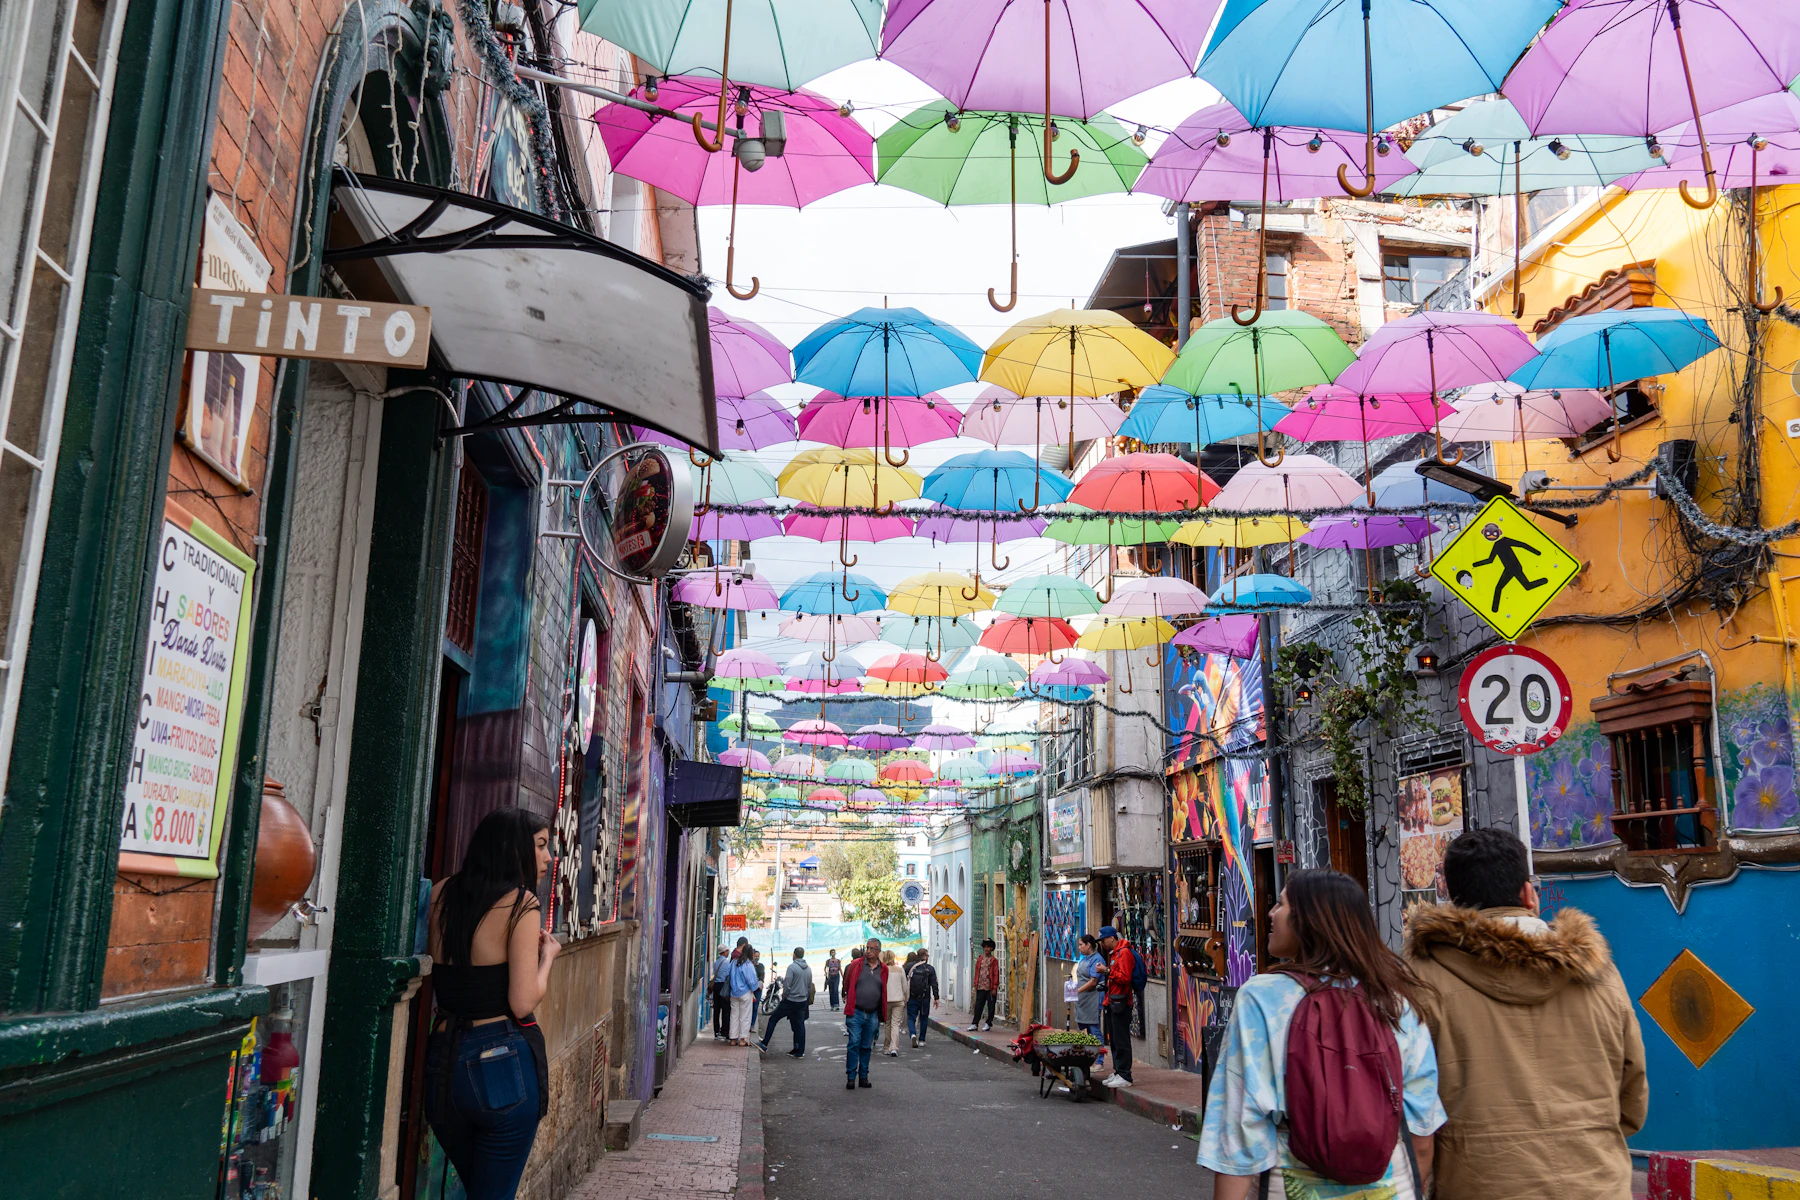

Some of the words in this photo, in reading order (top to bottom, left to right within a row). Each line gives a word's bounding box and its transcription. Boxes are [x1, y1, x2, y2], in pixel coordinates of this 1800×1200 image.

[183, 541, 239, 594] TRADICIONAL
[208, 585, 215, 605] Y
[161, 618, 199, 658] Donde
[177, 594, 230, 642] SABORES
[1482, 674, 1551, 724] 20
[148, 753, 172, 776] MANGO
[143, 803, 195, 845] $8.000
